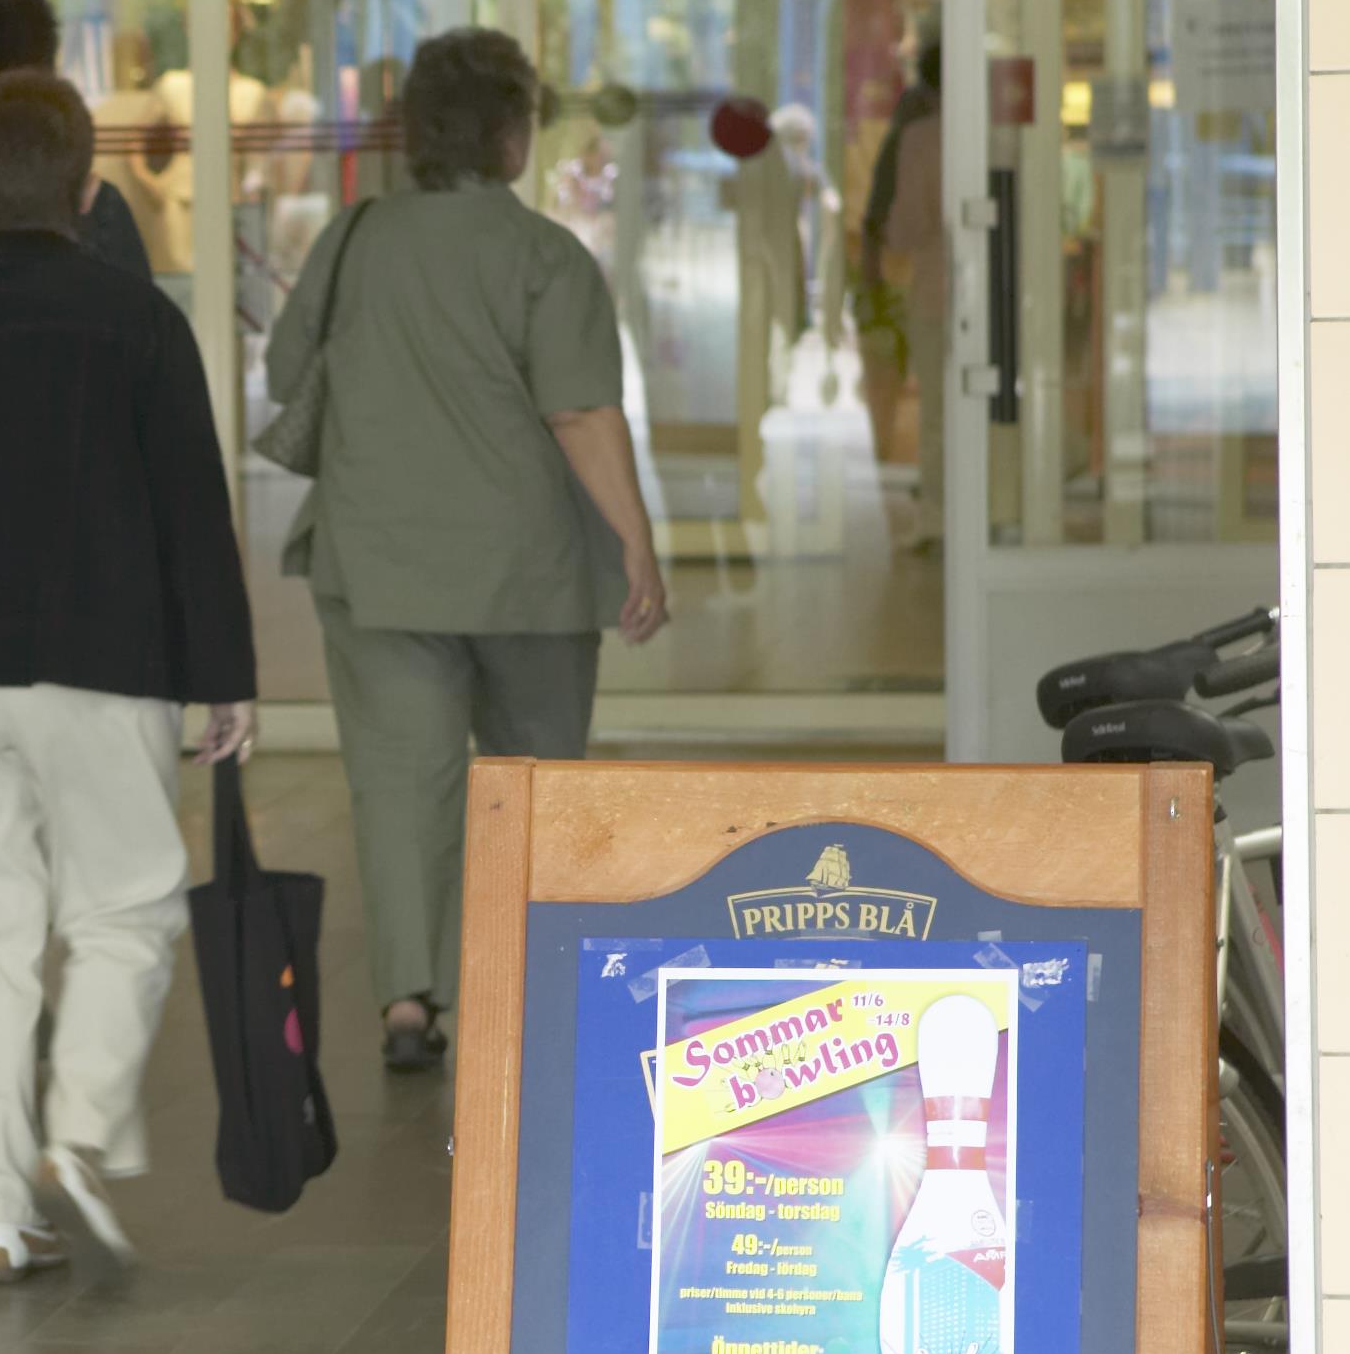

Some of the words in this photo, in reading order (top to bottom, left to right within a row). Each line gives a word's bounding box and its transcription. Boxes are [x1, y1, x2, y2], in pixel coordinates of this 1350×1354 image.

[743, 902, 850, 935] PRIPPS
[859, 902, 916, 938] BLÅ
[853, 993, 884, 1007] 11/6
[673, 997, 843, 1087] Sommar
[729, 1033, 900, 1109] bowling
[703, 1160, 844, 1197] 39:-/person
[705, 1201, 765, 1221] Söndag
[778, 1202, 840, 1221] torsdag
[726, 1261, 768, 1276] Fredag
